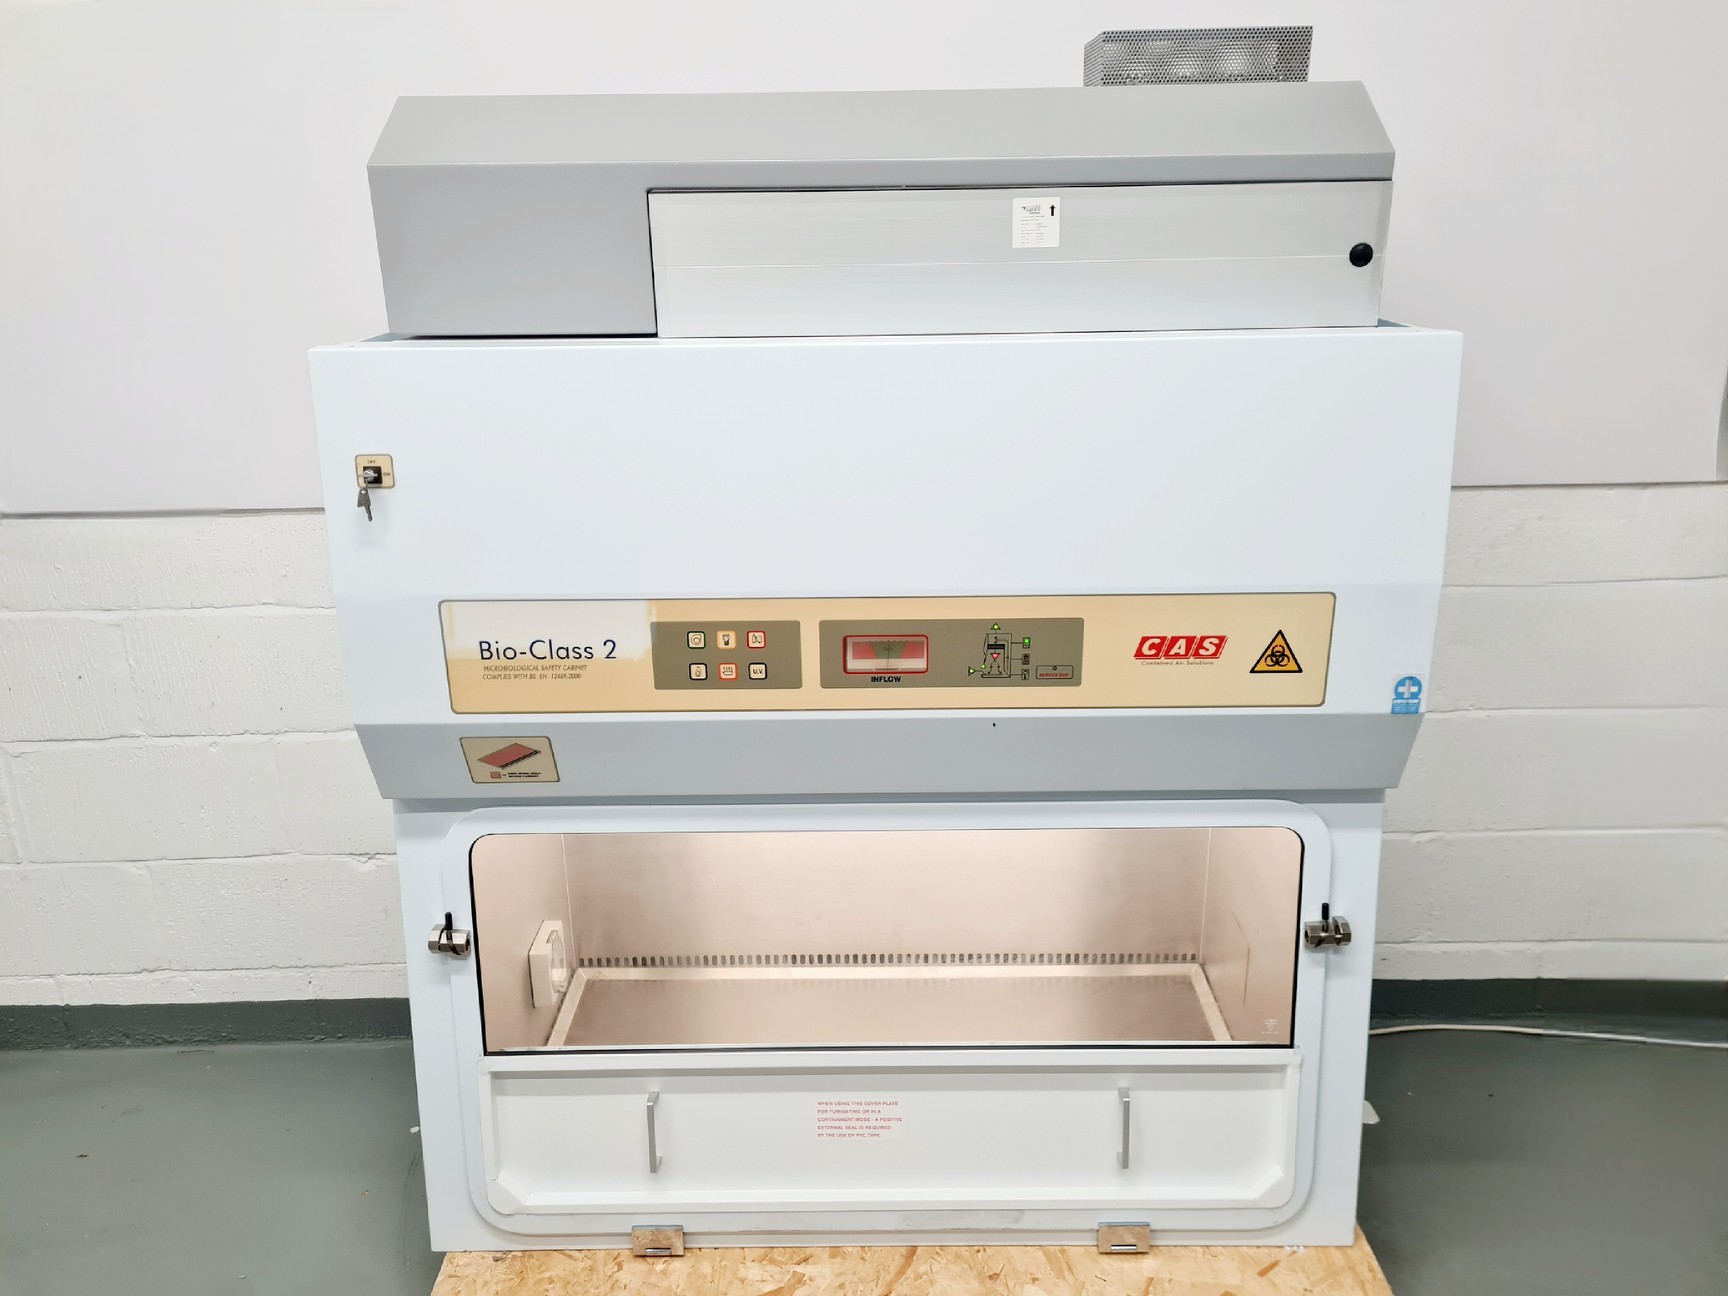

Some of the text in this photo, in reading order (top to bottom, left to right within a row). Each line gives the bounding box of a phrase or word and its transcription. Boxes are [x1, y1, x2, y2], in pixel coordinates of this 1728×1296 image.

[479, 639, 617, 660] Bio-Class 2
[1138, 637, 1223, 657] CAS
